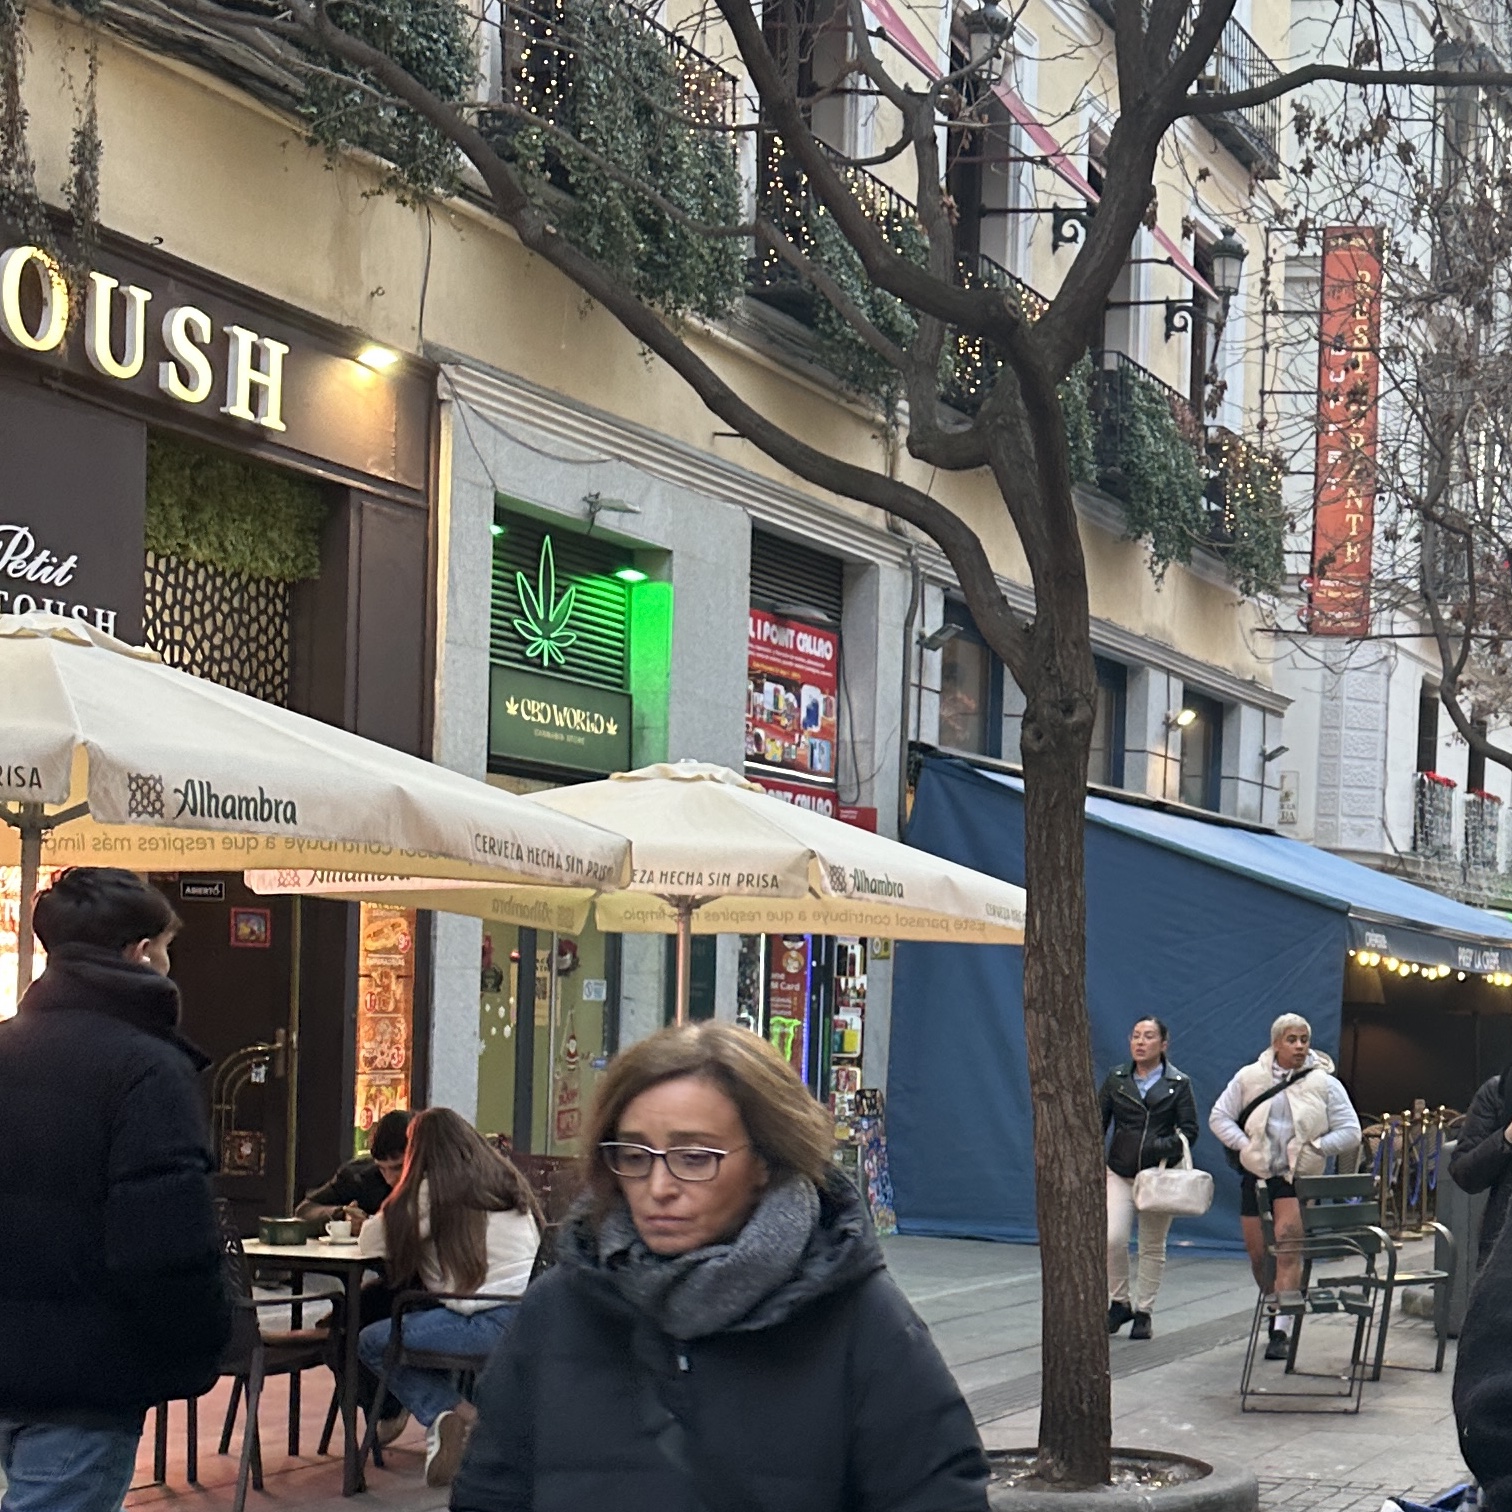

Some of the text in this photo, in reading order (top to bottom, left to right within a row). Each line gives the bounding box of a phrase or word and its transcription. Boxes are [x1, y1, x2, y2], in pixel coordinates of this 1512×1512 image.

[0, 245, 290, 432] OUSH
[0, 524, 79, 587] Petit
[520, 698, 605, 735] CBD WORLD
[173, 778, 298, 825] Alhambra
[474, 832, 524, 862] CERVEZA
[527, 845, 563, 872] HECHA
[565, 855, 584, 875] SIN
[659, 869, 703, 886] HECHA
[708, 871, 731, 887] SIN
[736, 872, 780, 889] PRISA
[849, 867, 904, 899] Alhambra
